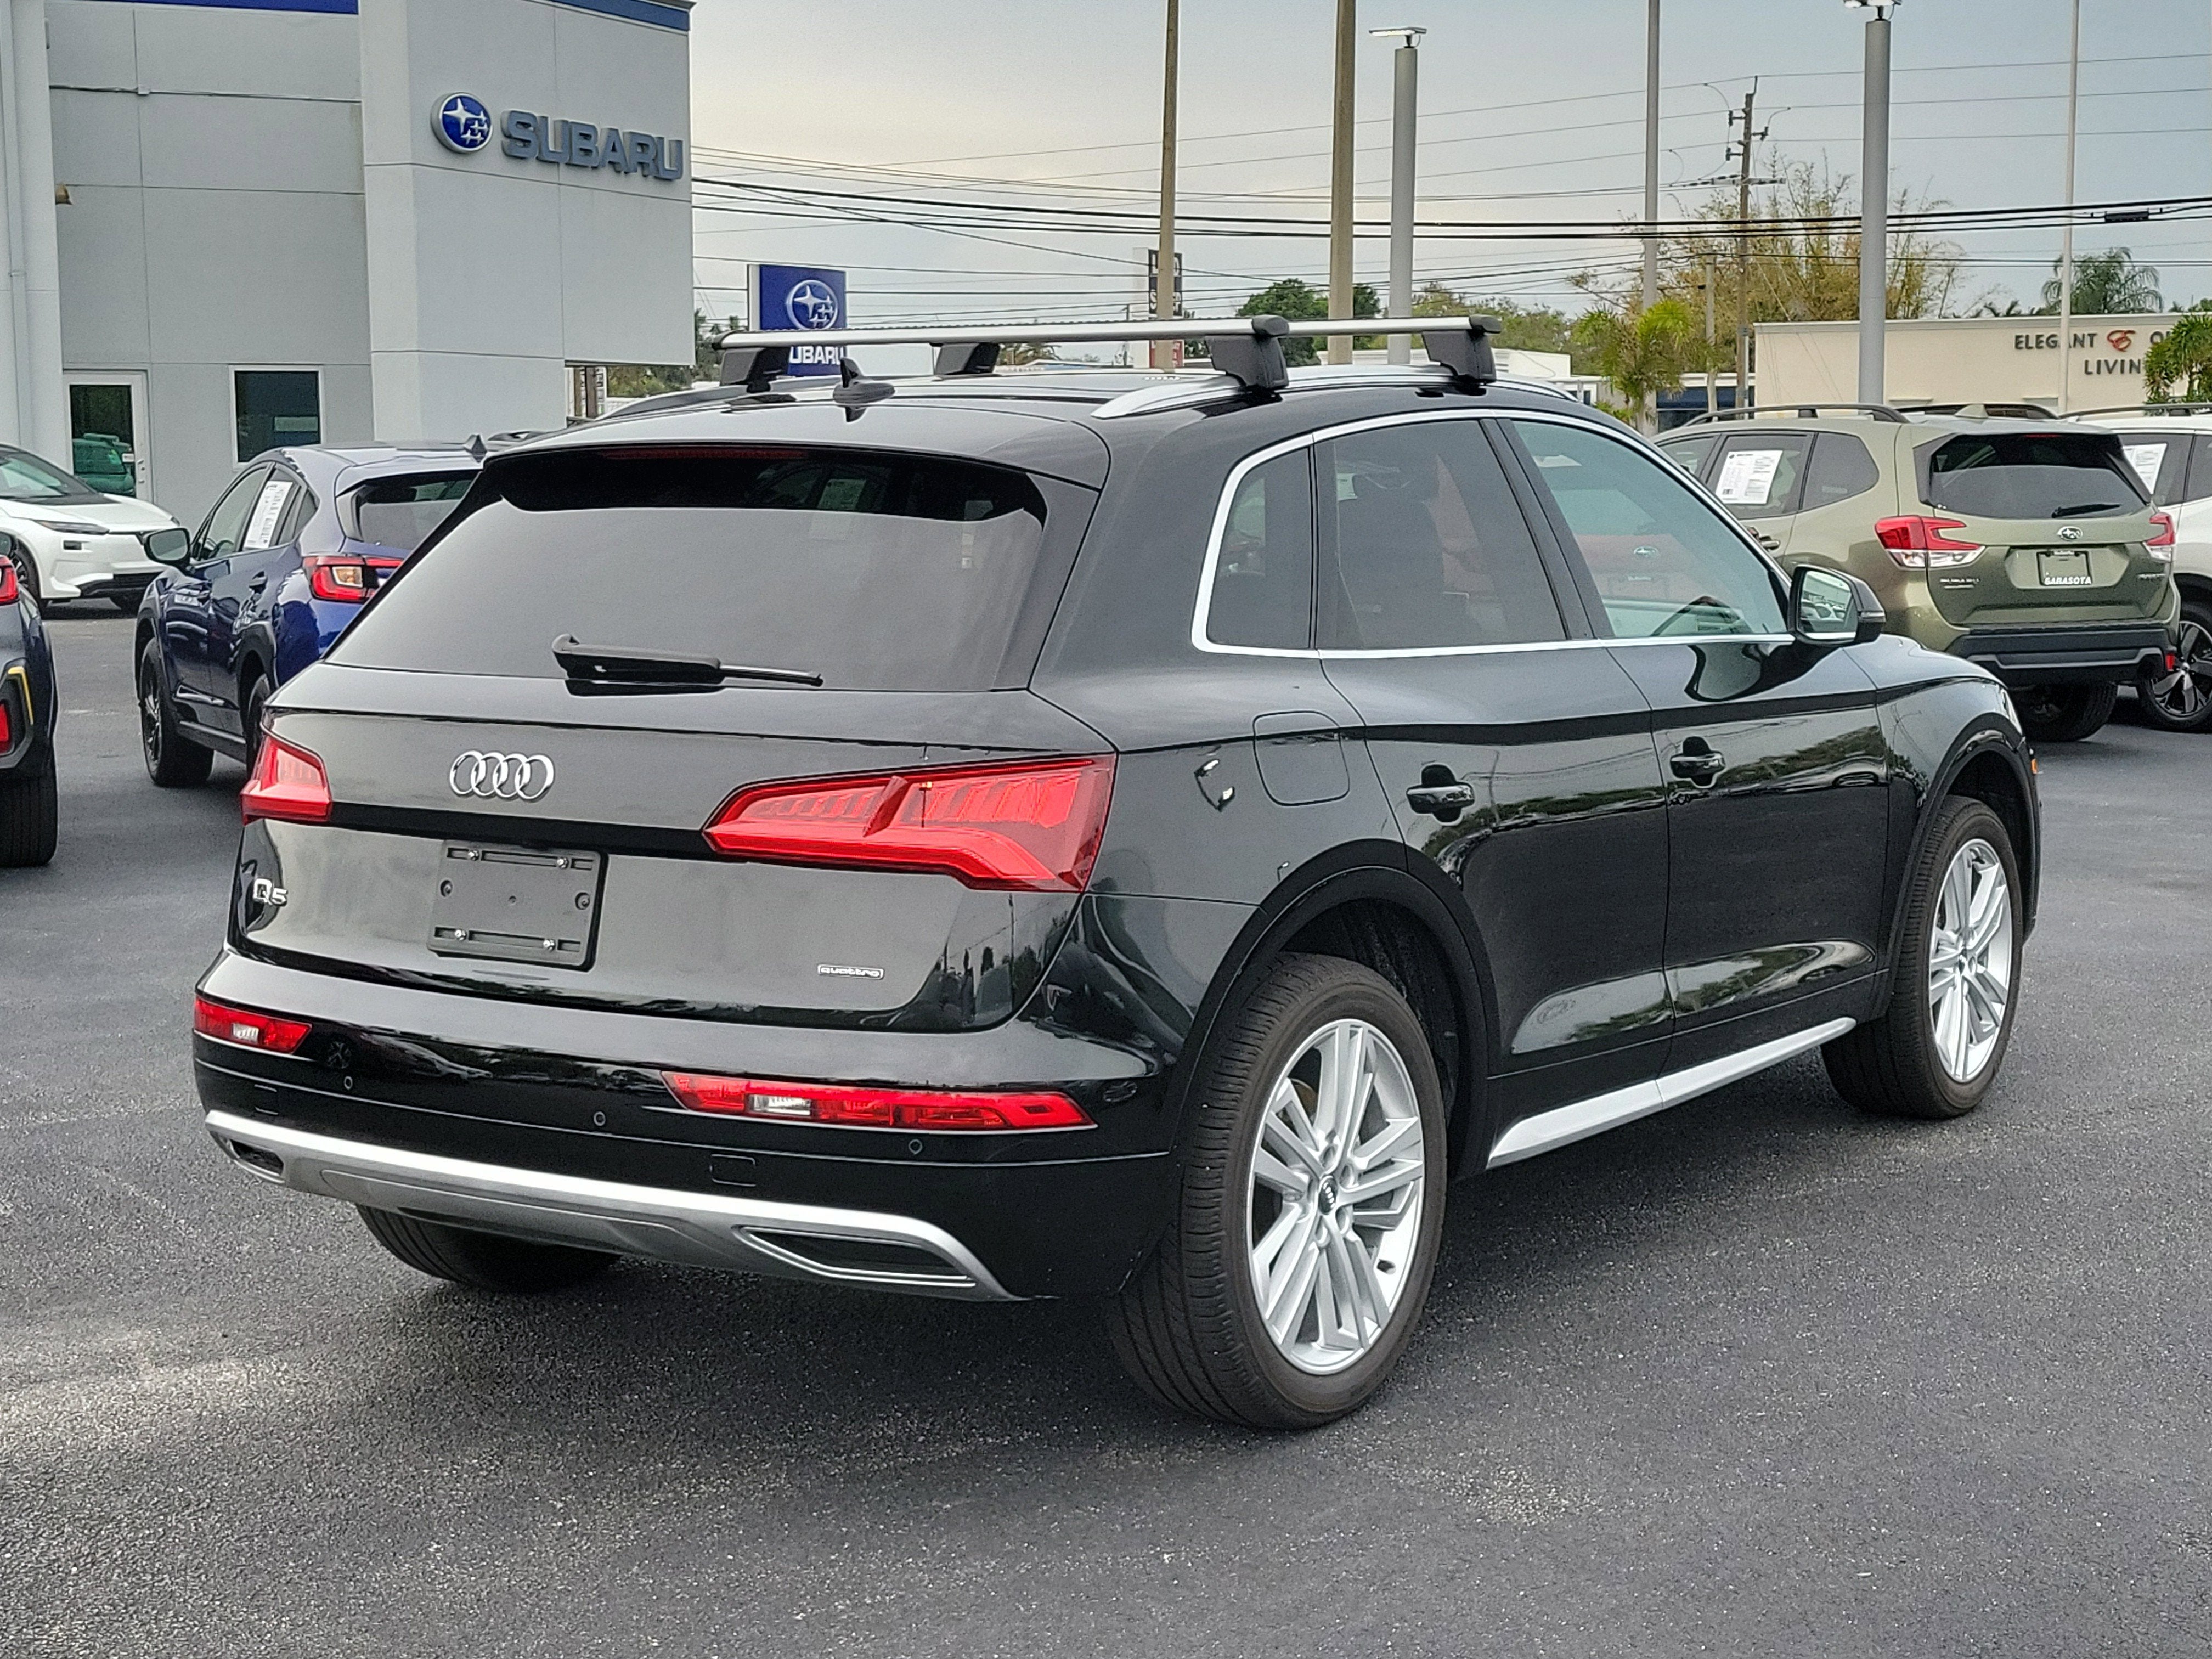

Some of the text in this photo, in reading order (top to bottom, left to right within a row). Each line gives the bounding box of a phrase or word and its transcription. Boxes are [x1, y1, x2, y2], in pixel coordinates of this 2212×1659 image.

[501, 110, 683, 180] SUBARU
[2015, 333, 2097, 349] ELEGNT
[789, 345, 845, 365] UBARU
[2085, 359, 2141, 375] LIVIN
[253, 878, 287, 906] Q5
[820, 966, 881, 978] quattro
